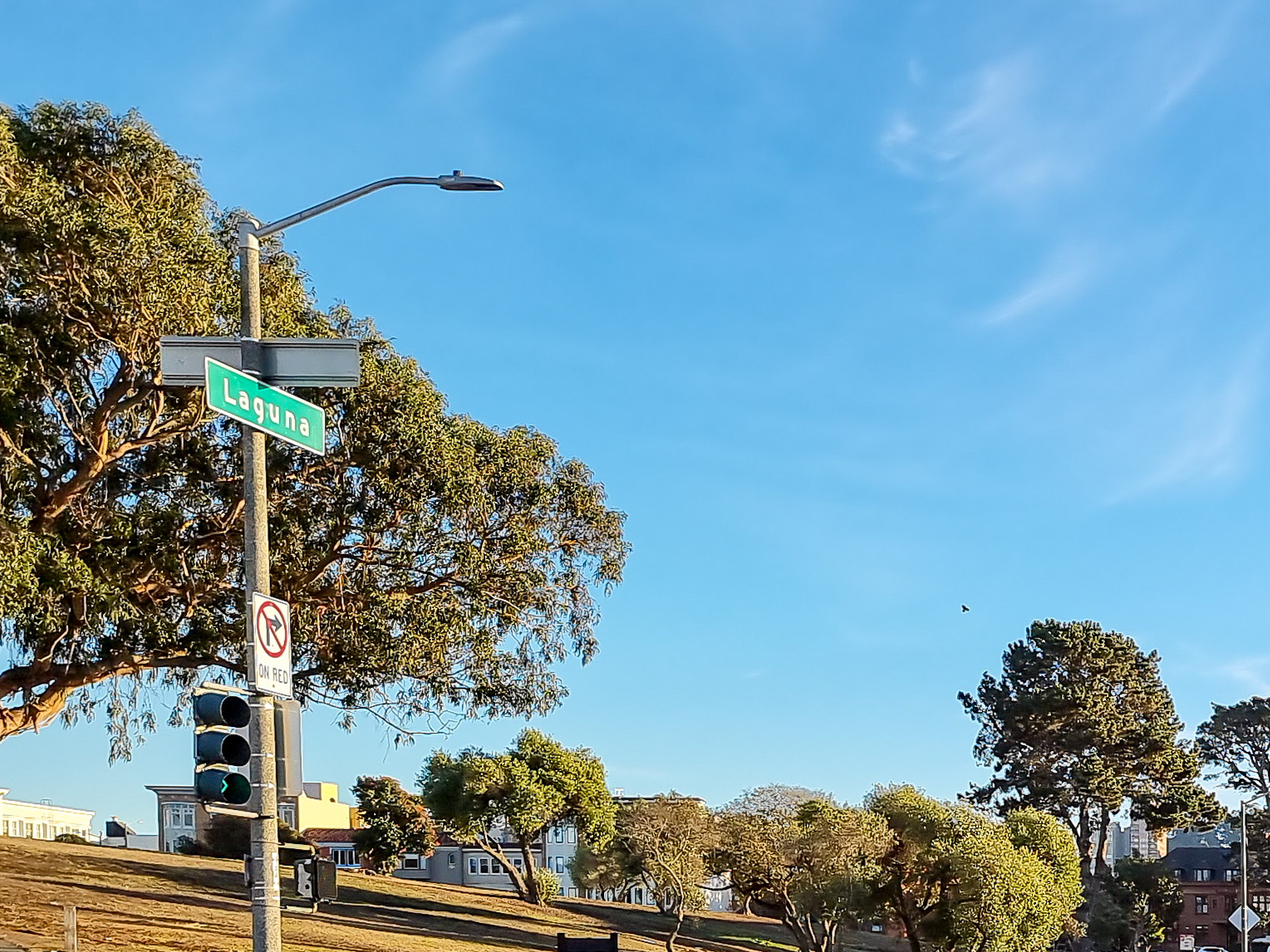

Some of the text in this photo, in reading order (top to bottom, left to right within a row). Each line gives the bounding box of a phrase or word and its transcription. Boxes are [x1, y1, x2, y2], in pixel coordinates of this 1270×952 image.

[223, 377, 310, 438] Laguna
[259, 663, 288, 684] ON RED
